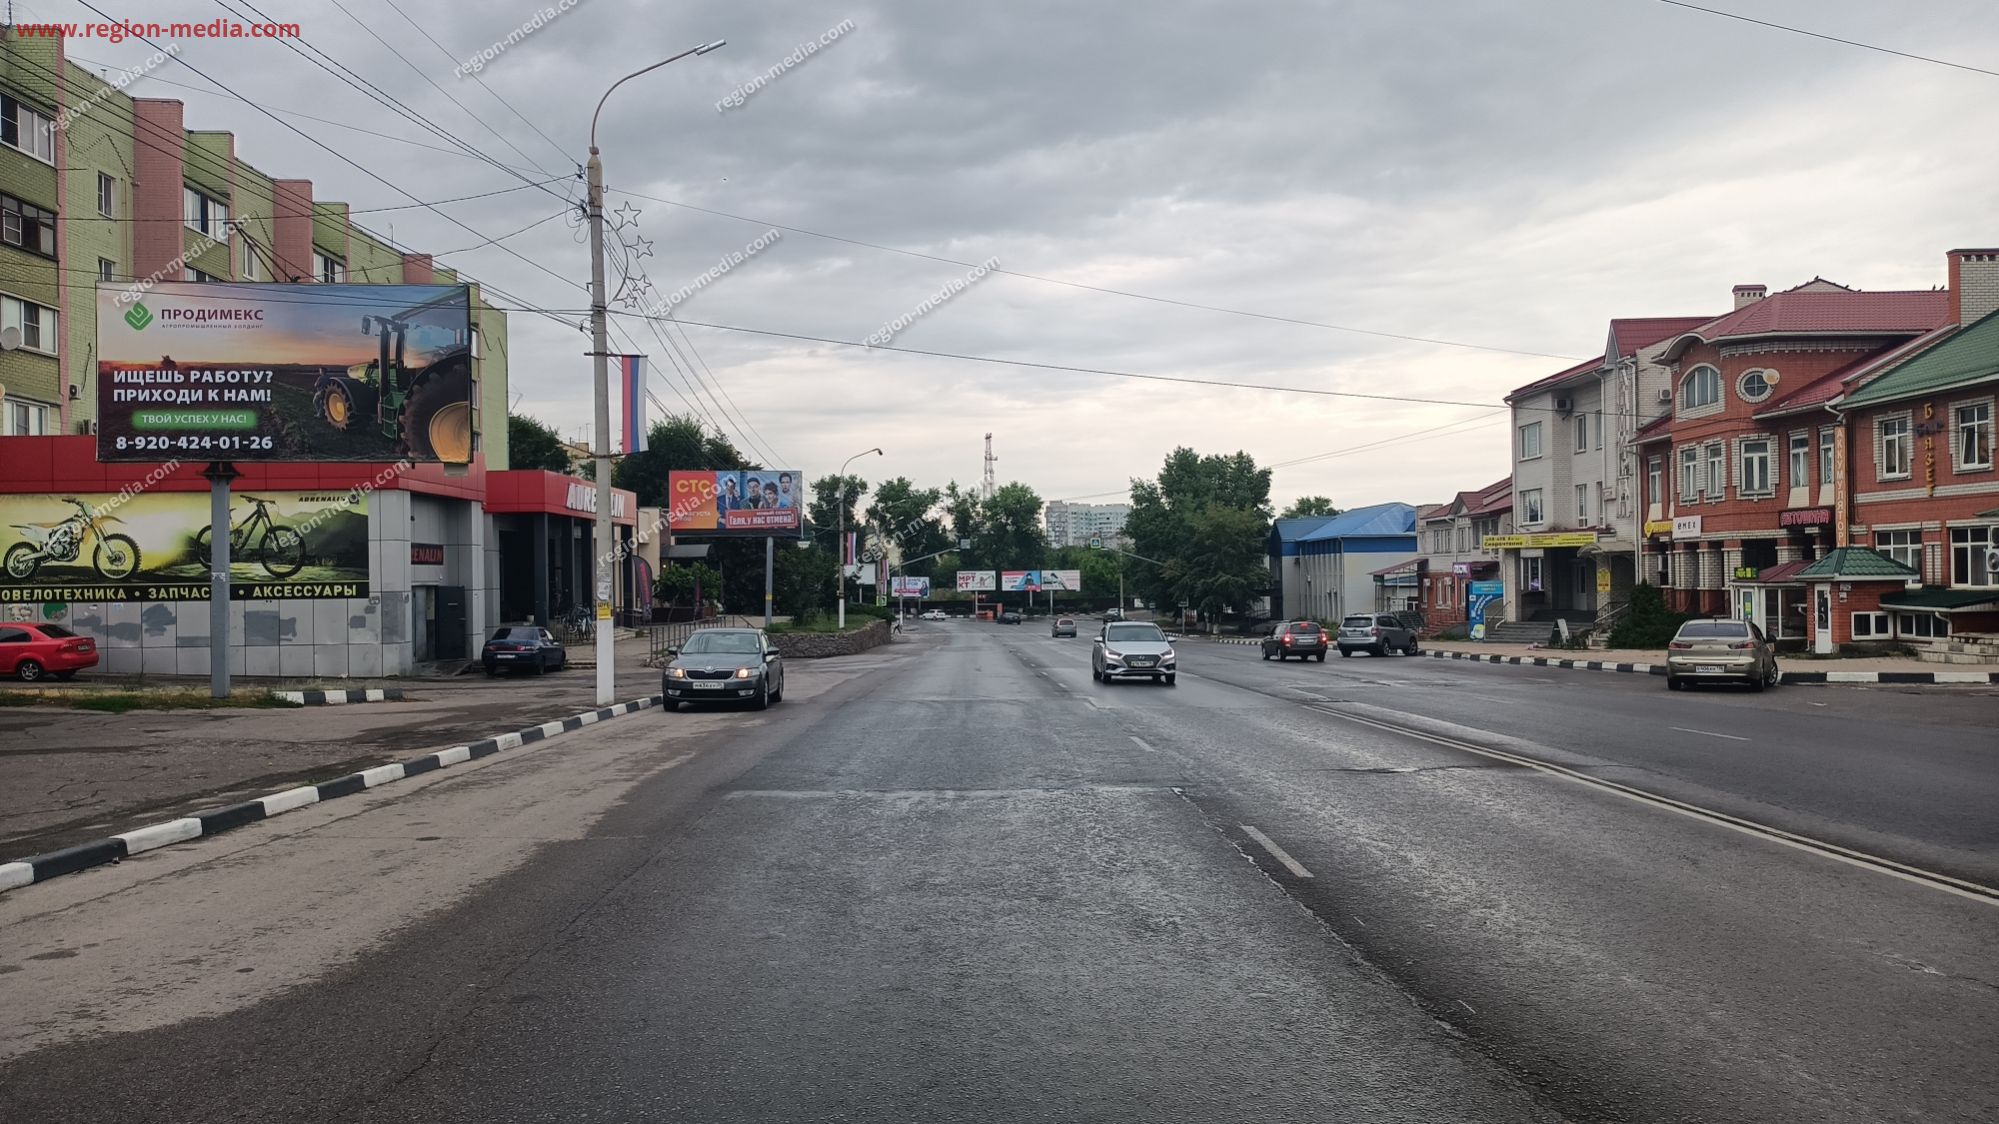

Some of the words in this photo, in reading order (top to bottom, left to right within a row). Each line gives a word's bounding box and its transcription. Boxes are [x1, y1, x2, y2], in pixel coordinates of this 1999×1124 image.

[161, 308, 264, 322] ПРОДИМЕКС
[113, 370, 185, 386] ИЩЕШЬ
[190, 370, 274, 384] РАБОТУ?
[113, 389, 203, 405] ПРИХОДИ
[207, 389, 220, 402] К
[224, 389, 272, 402] НАМ!
[142, 413, 172, 424] ТВОЙ
[175, 414, 209, 424] УСПЕХ
[211, 414, 219, 424] У
[221, 414, 247, 424] НАС!
[116, 436, 273, 450] 8-920-424-01-26
[676, 479, 711, 492] СТС
[567, 482, 625, 518] ADRELIN
[412, 548, 443, 562] ENALIN
[148, 586, 211, 599] ЗАПЧАС
[253, 584, 357, 598] АКСЕССУАРЫ
